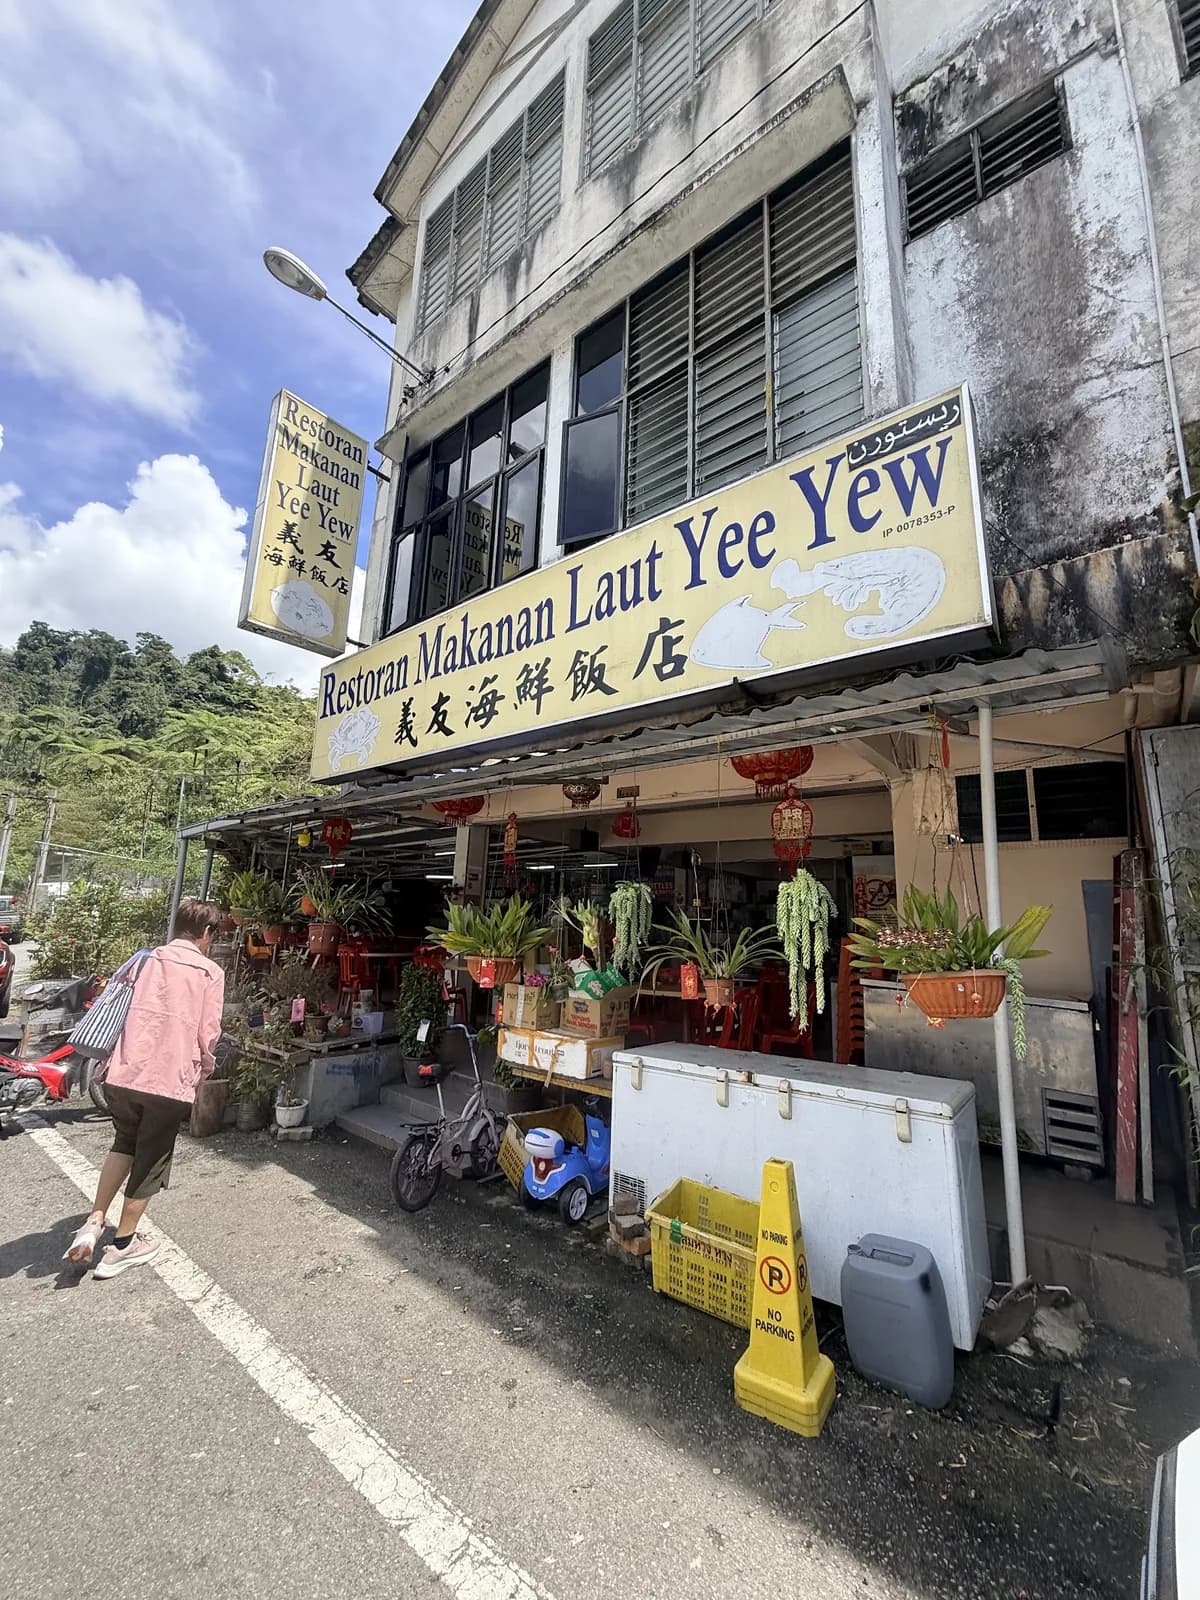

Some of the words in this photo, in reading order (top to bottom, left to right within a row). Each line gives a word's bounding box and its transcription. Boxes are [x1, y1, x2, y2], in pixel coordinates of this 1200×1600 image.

[283, 396, 363, 465] Restoran
[279, 424, 360, 490] Makanan
[276, 480, 310, 520] Yee
[317, 502, 354, 541] Yew
[296, 464, 340, 507] Laut
[276, 519, 342, 570] 義友
[882, 527, 894, 538] IP
[896, 505, 956, 533] 0078353-P
[263, 544, 350, 596] 海鮮飯店
[320, 655, 408, 719] Restoran
[414, 597, 554, 685] Makanan
[565, 540, 663, 634] Laut
[674, 507, 776, 590] Yee
[789, 435, 953, 551] Yew
[393, 616, 689, 748] 義友海鮮飯店
[761, 1229, 769, 1241] NO
[769, 1231, 788, 1246] PARKING
[755, 1318, 795, 1342] PARKING
[767, 1307, 782, 1322] NO
